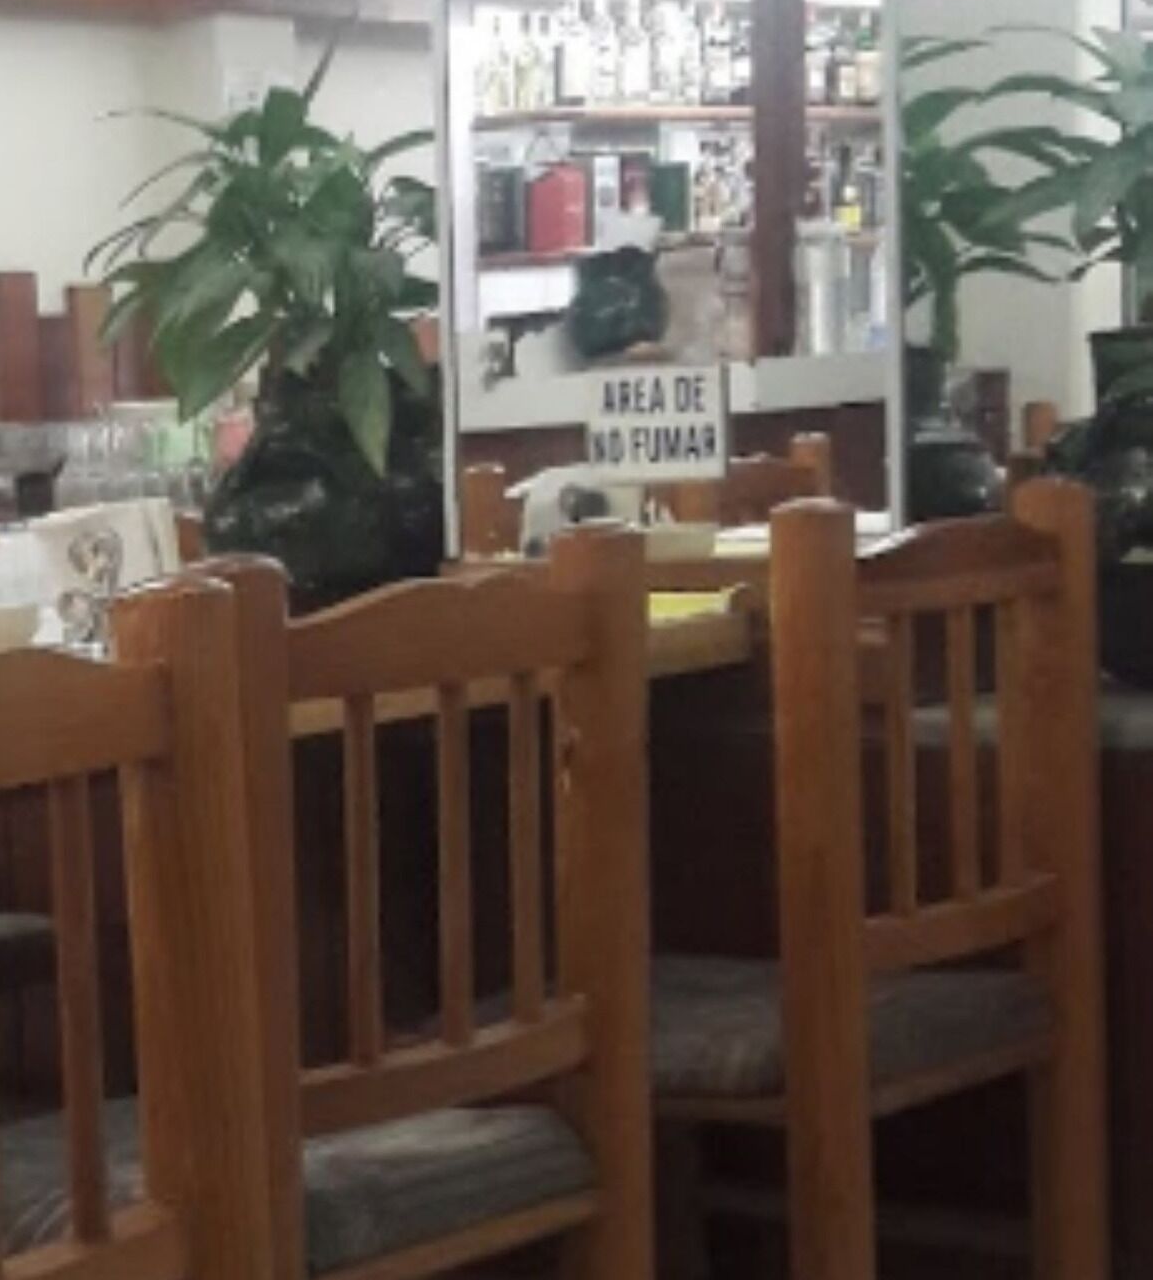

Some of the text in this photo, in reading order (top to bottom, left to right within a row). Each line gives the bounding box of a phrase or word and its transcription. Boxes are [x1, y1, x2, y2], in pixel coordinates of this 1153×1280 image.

[603, 375, 706, 414] AREA DE
[591, 423, 717, 465] NO FUMAR
